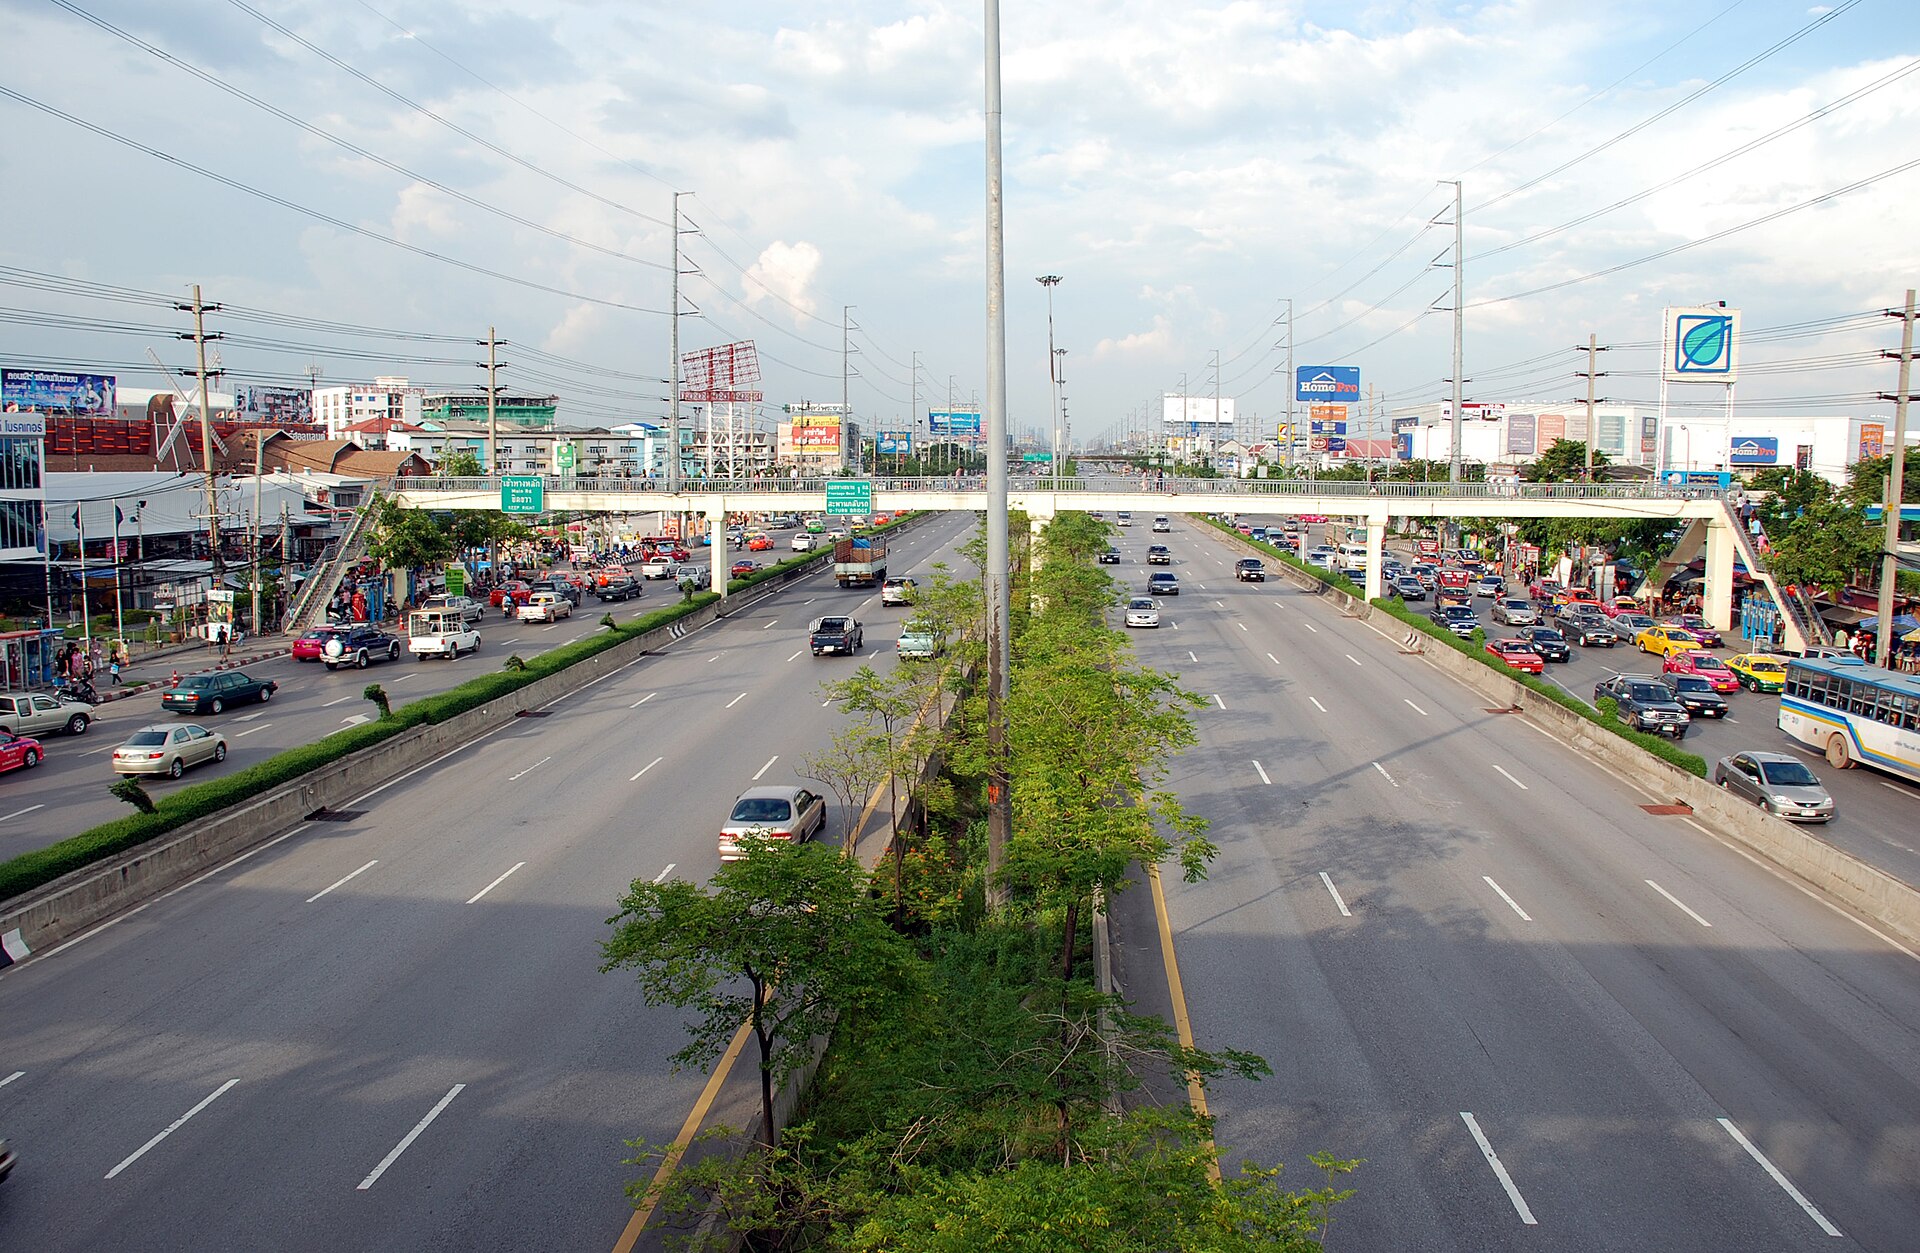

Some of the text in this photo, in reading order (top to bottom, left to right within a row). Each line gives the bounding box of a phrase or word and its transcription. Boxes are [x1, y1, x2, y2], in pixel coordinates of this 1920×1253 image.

[1300, 382, 1358, 392] HomePro
[503, 478, 541, 488] เข้าทางหลัก
